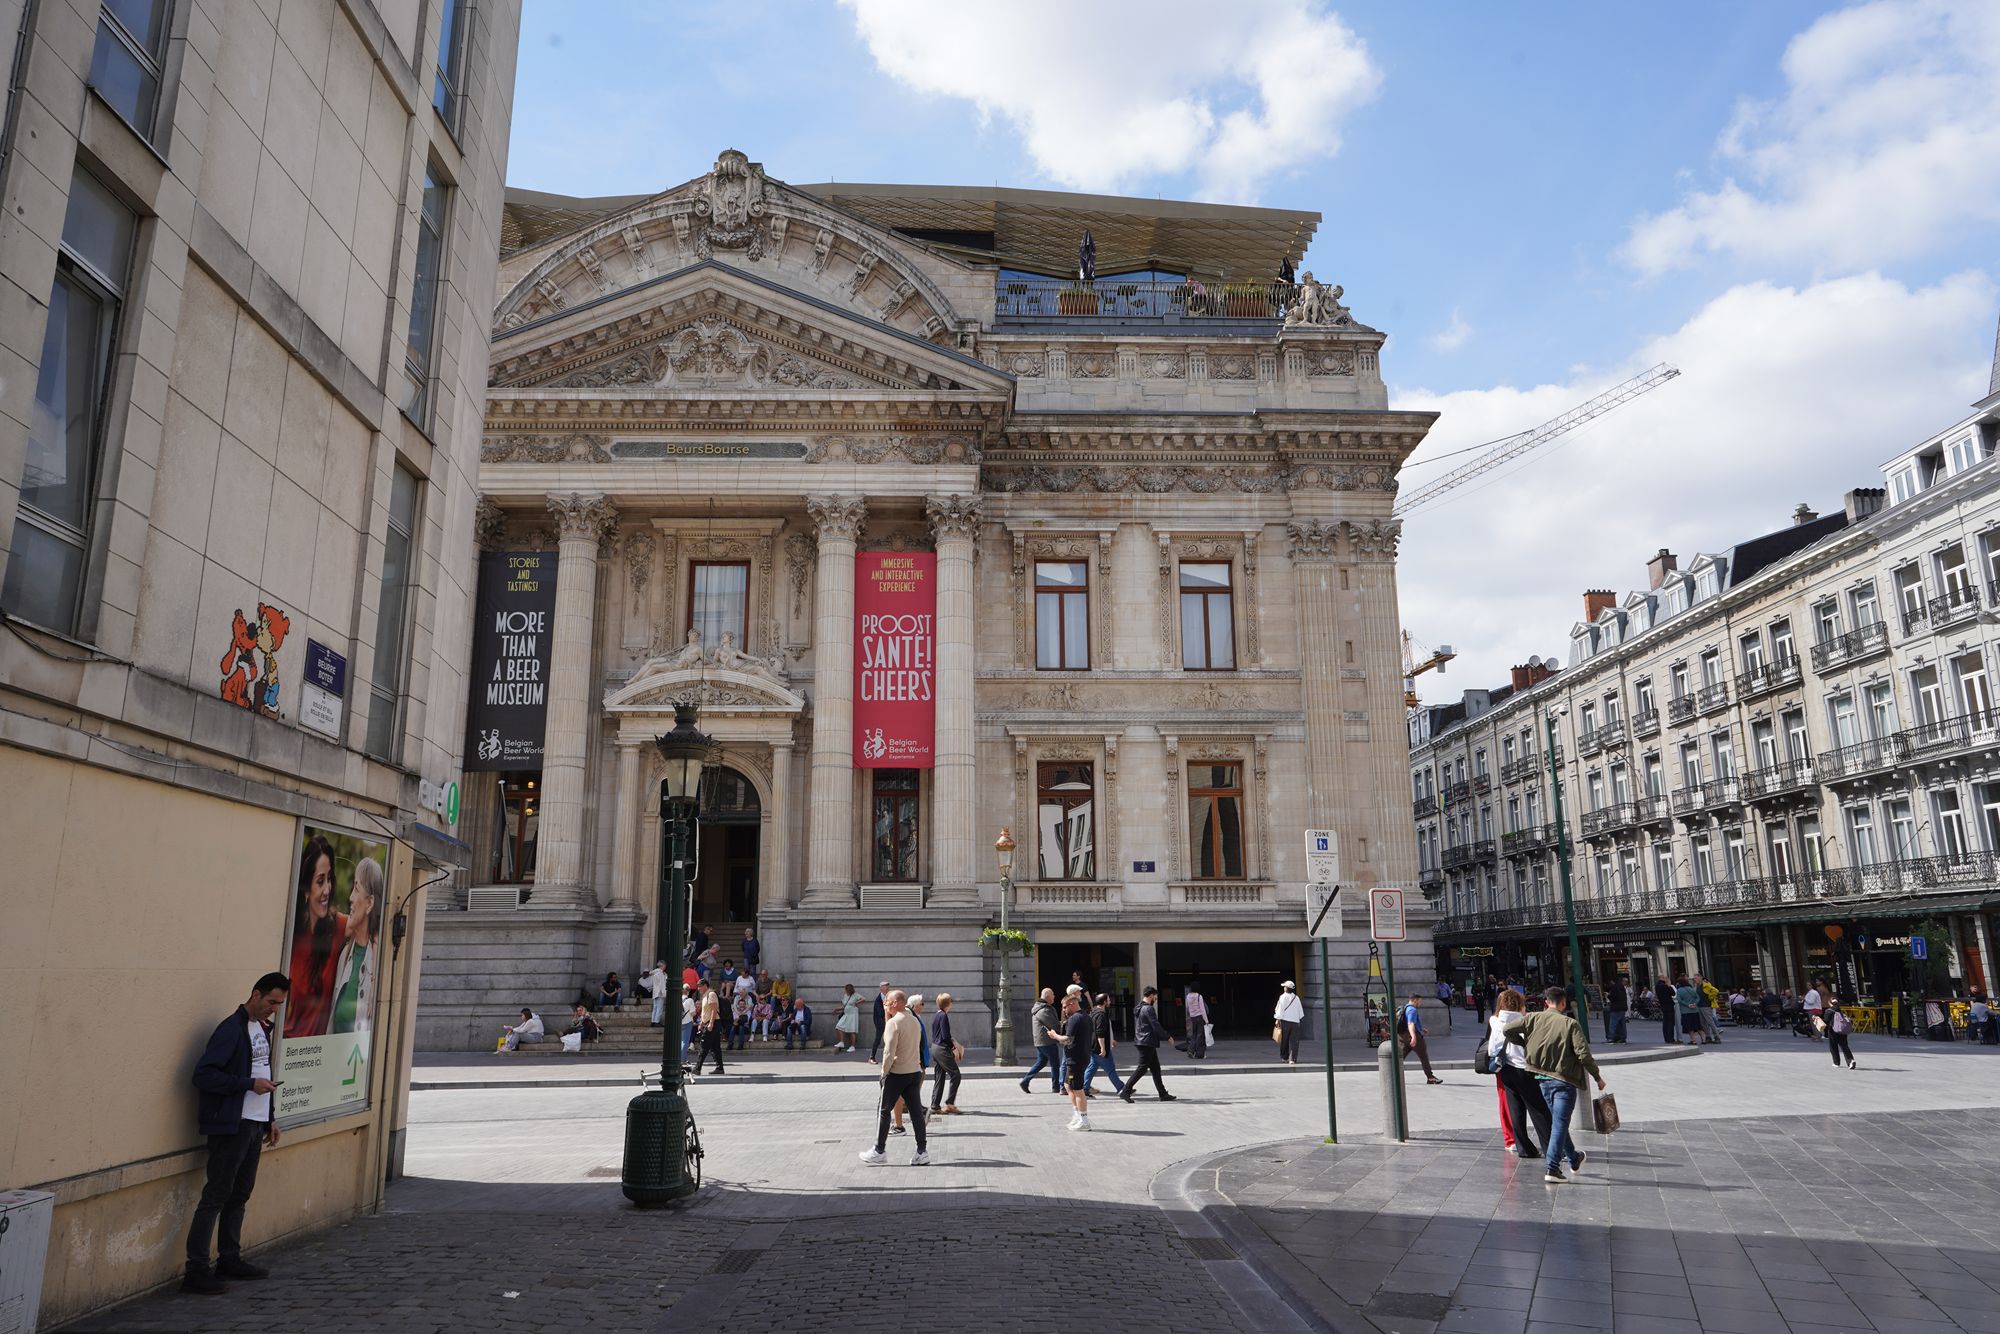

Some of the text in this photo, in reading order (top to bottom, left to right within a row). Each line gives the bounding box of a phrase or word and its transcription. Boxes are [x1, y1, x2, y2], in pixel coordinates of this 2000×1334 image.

[666, 443, 750, 455] BeursBourse
[509, 557, 540, 569] STORIES
[880, 558, 914, 569] IMMERSIVE
[516, 569, 530, 580] AND
[871, 569, 924, 581] AND INTERACTIVE
[507, 581, 538, 592] TASTINGS!
[879, 581, 916, 592] EXPERIENCE
[495, 611, 545, 633] MORE
[862, 614, 932, 635] PROOST
[501, 635, 536, 657] THAN
[492, 659, 540, 681] A BEER
[861, 670, 932, 701] CHEERS
[486, 683, 544, 705] MUSEUM
[504, 739, 533, 748] Belgian
[889, 738, 917, 747] Belgian
[286, 1044, 322, 1057] Bien entendre
[285, 1060, 314, 1071] commence
[282, 1084, 312, 1097] Beter horen
[280, 1101, 298, 1112] begint
